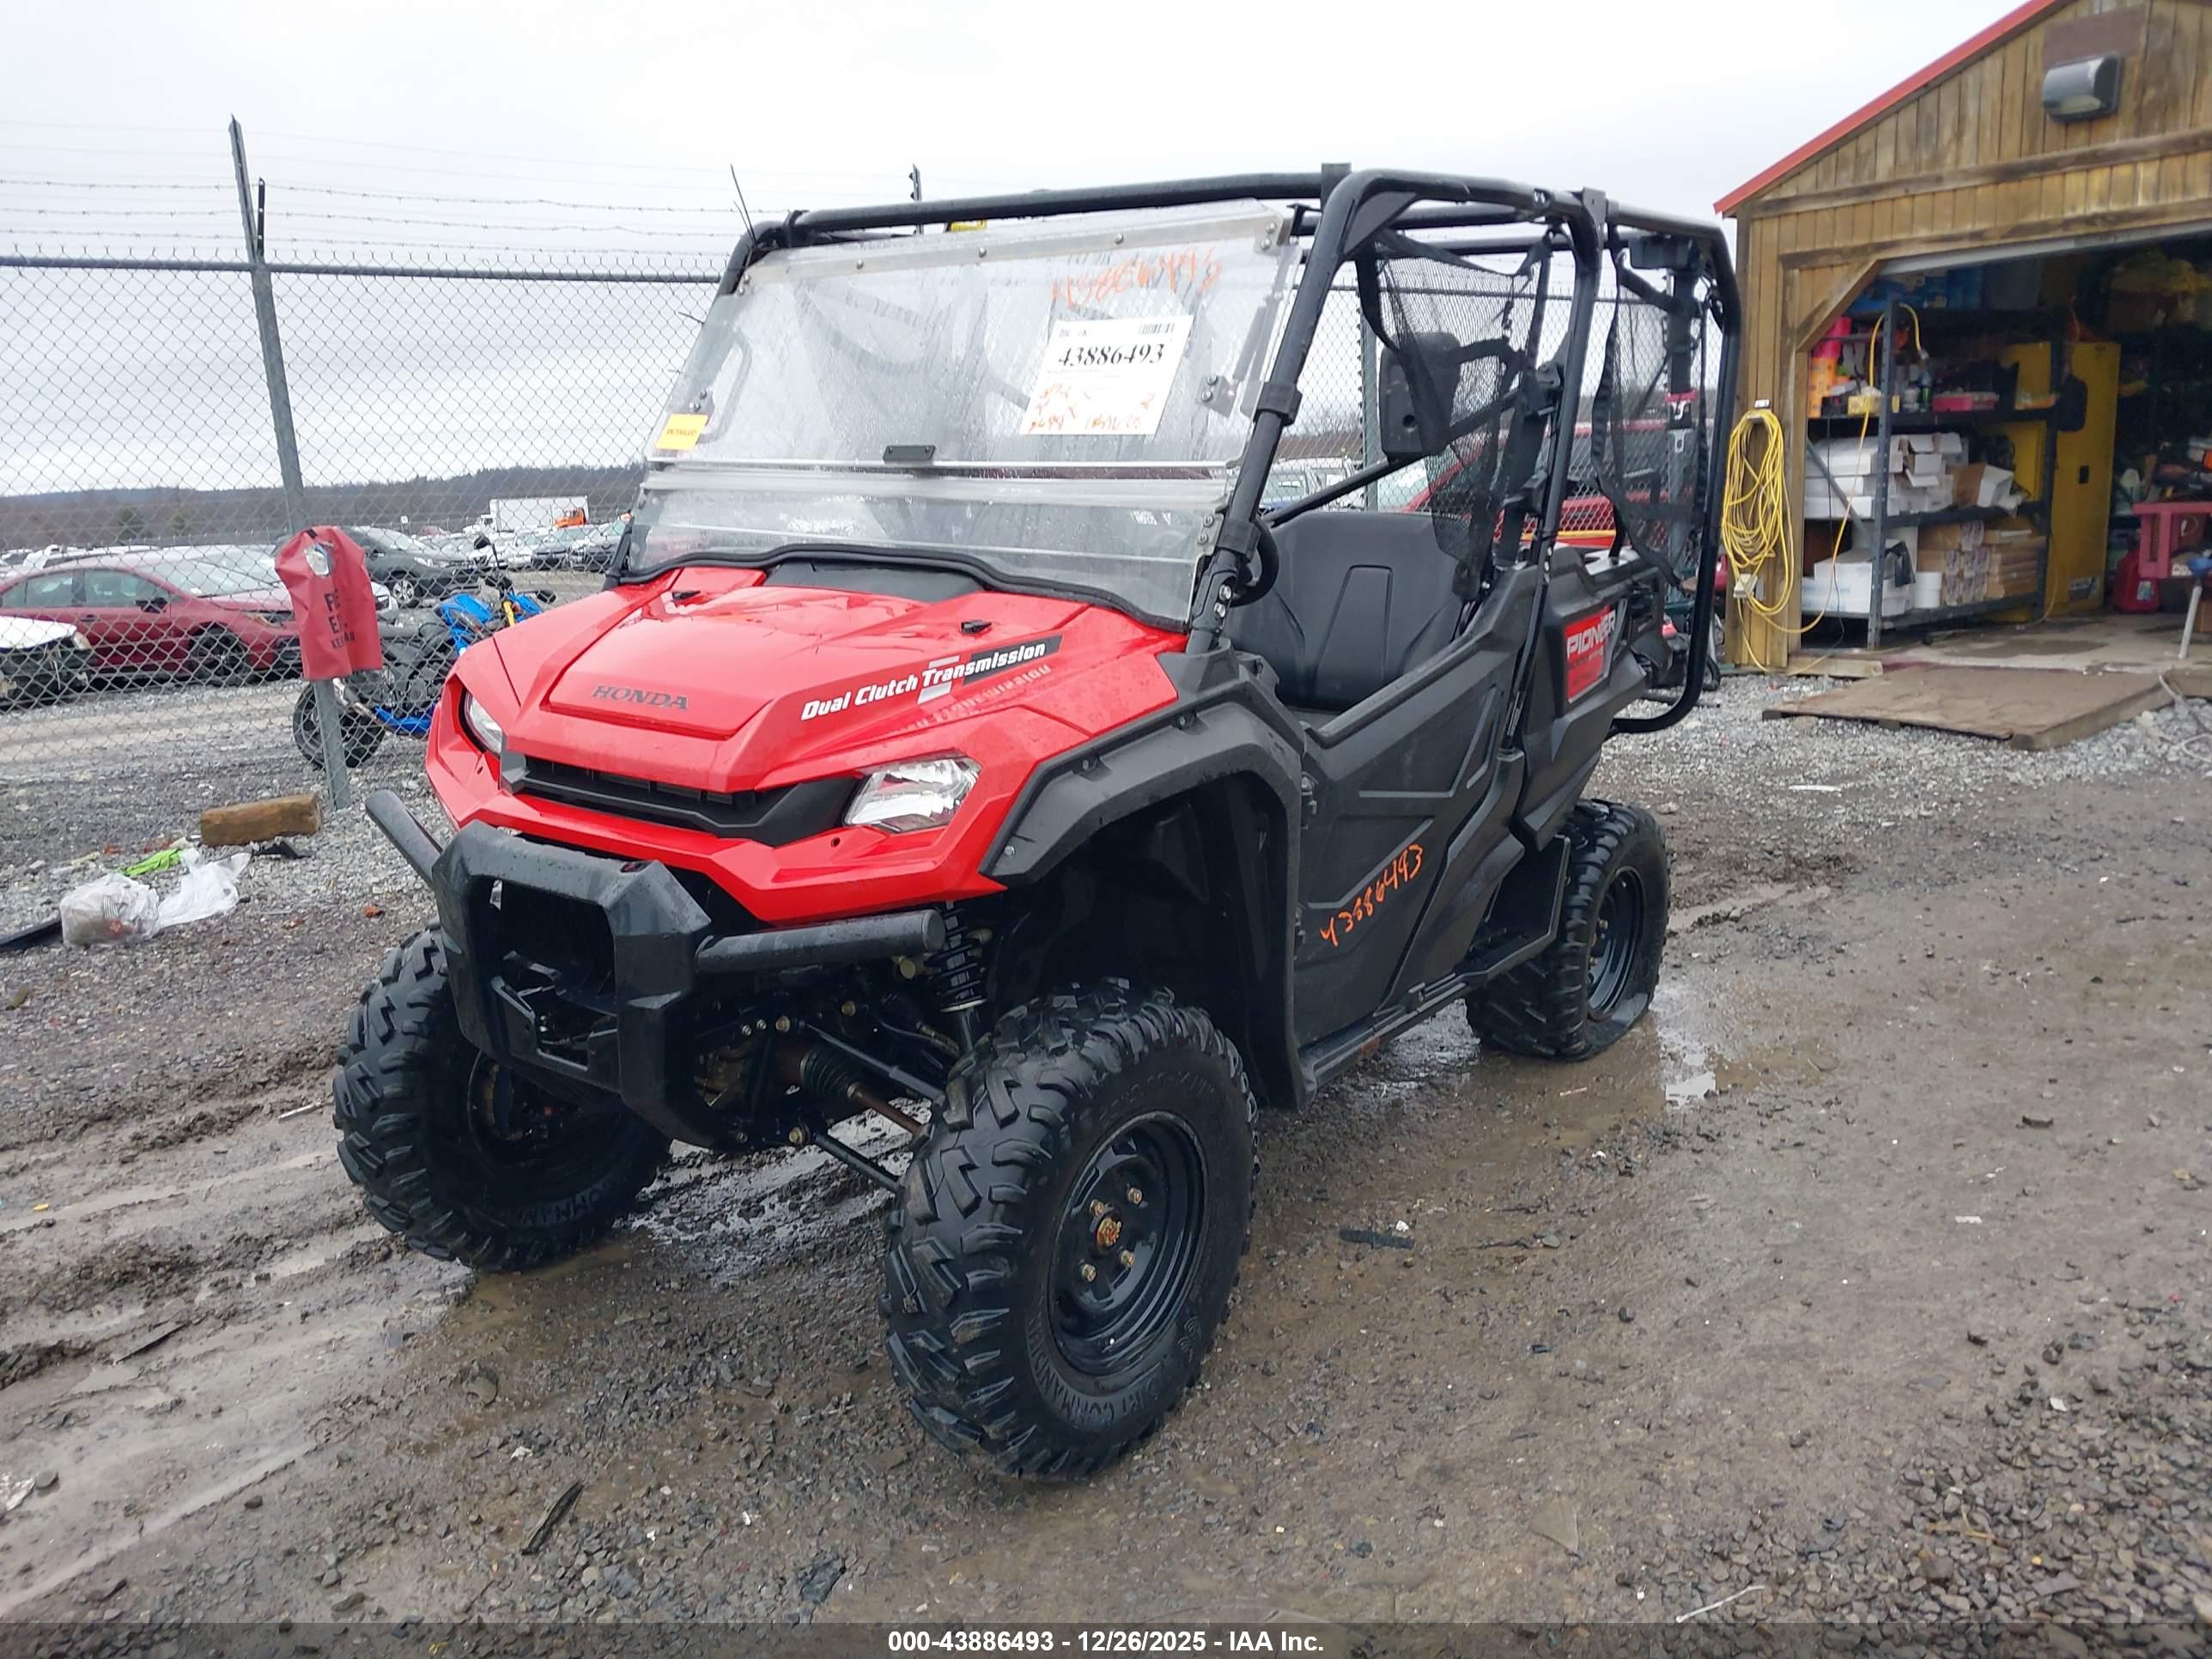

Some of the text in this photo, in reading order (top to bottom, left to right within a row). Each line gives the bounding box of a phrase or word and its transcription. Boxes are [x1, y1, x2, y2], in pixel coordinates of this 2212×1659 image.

[1058, 343, 1164, 366] 43886493
[800, 642, 1046, 721] Dual Clutch Transmission
[591, 684, 688, 711] HONDA
